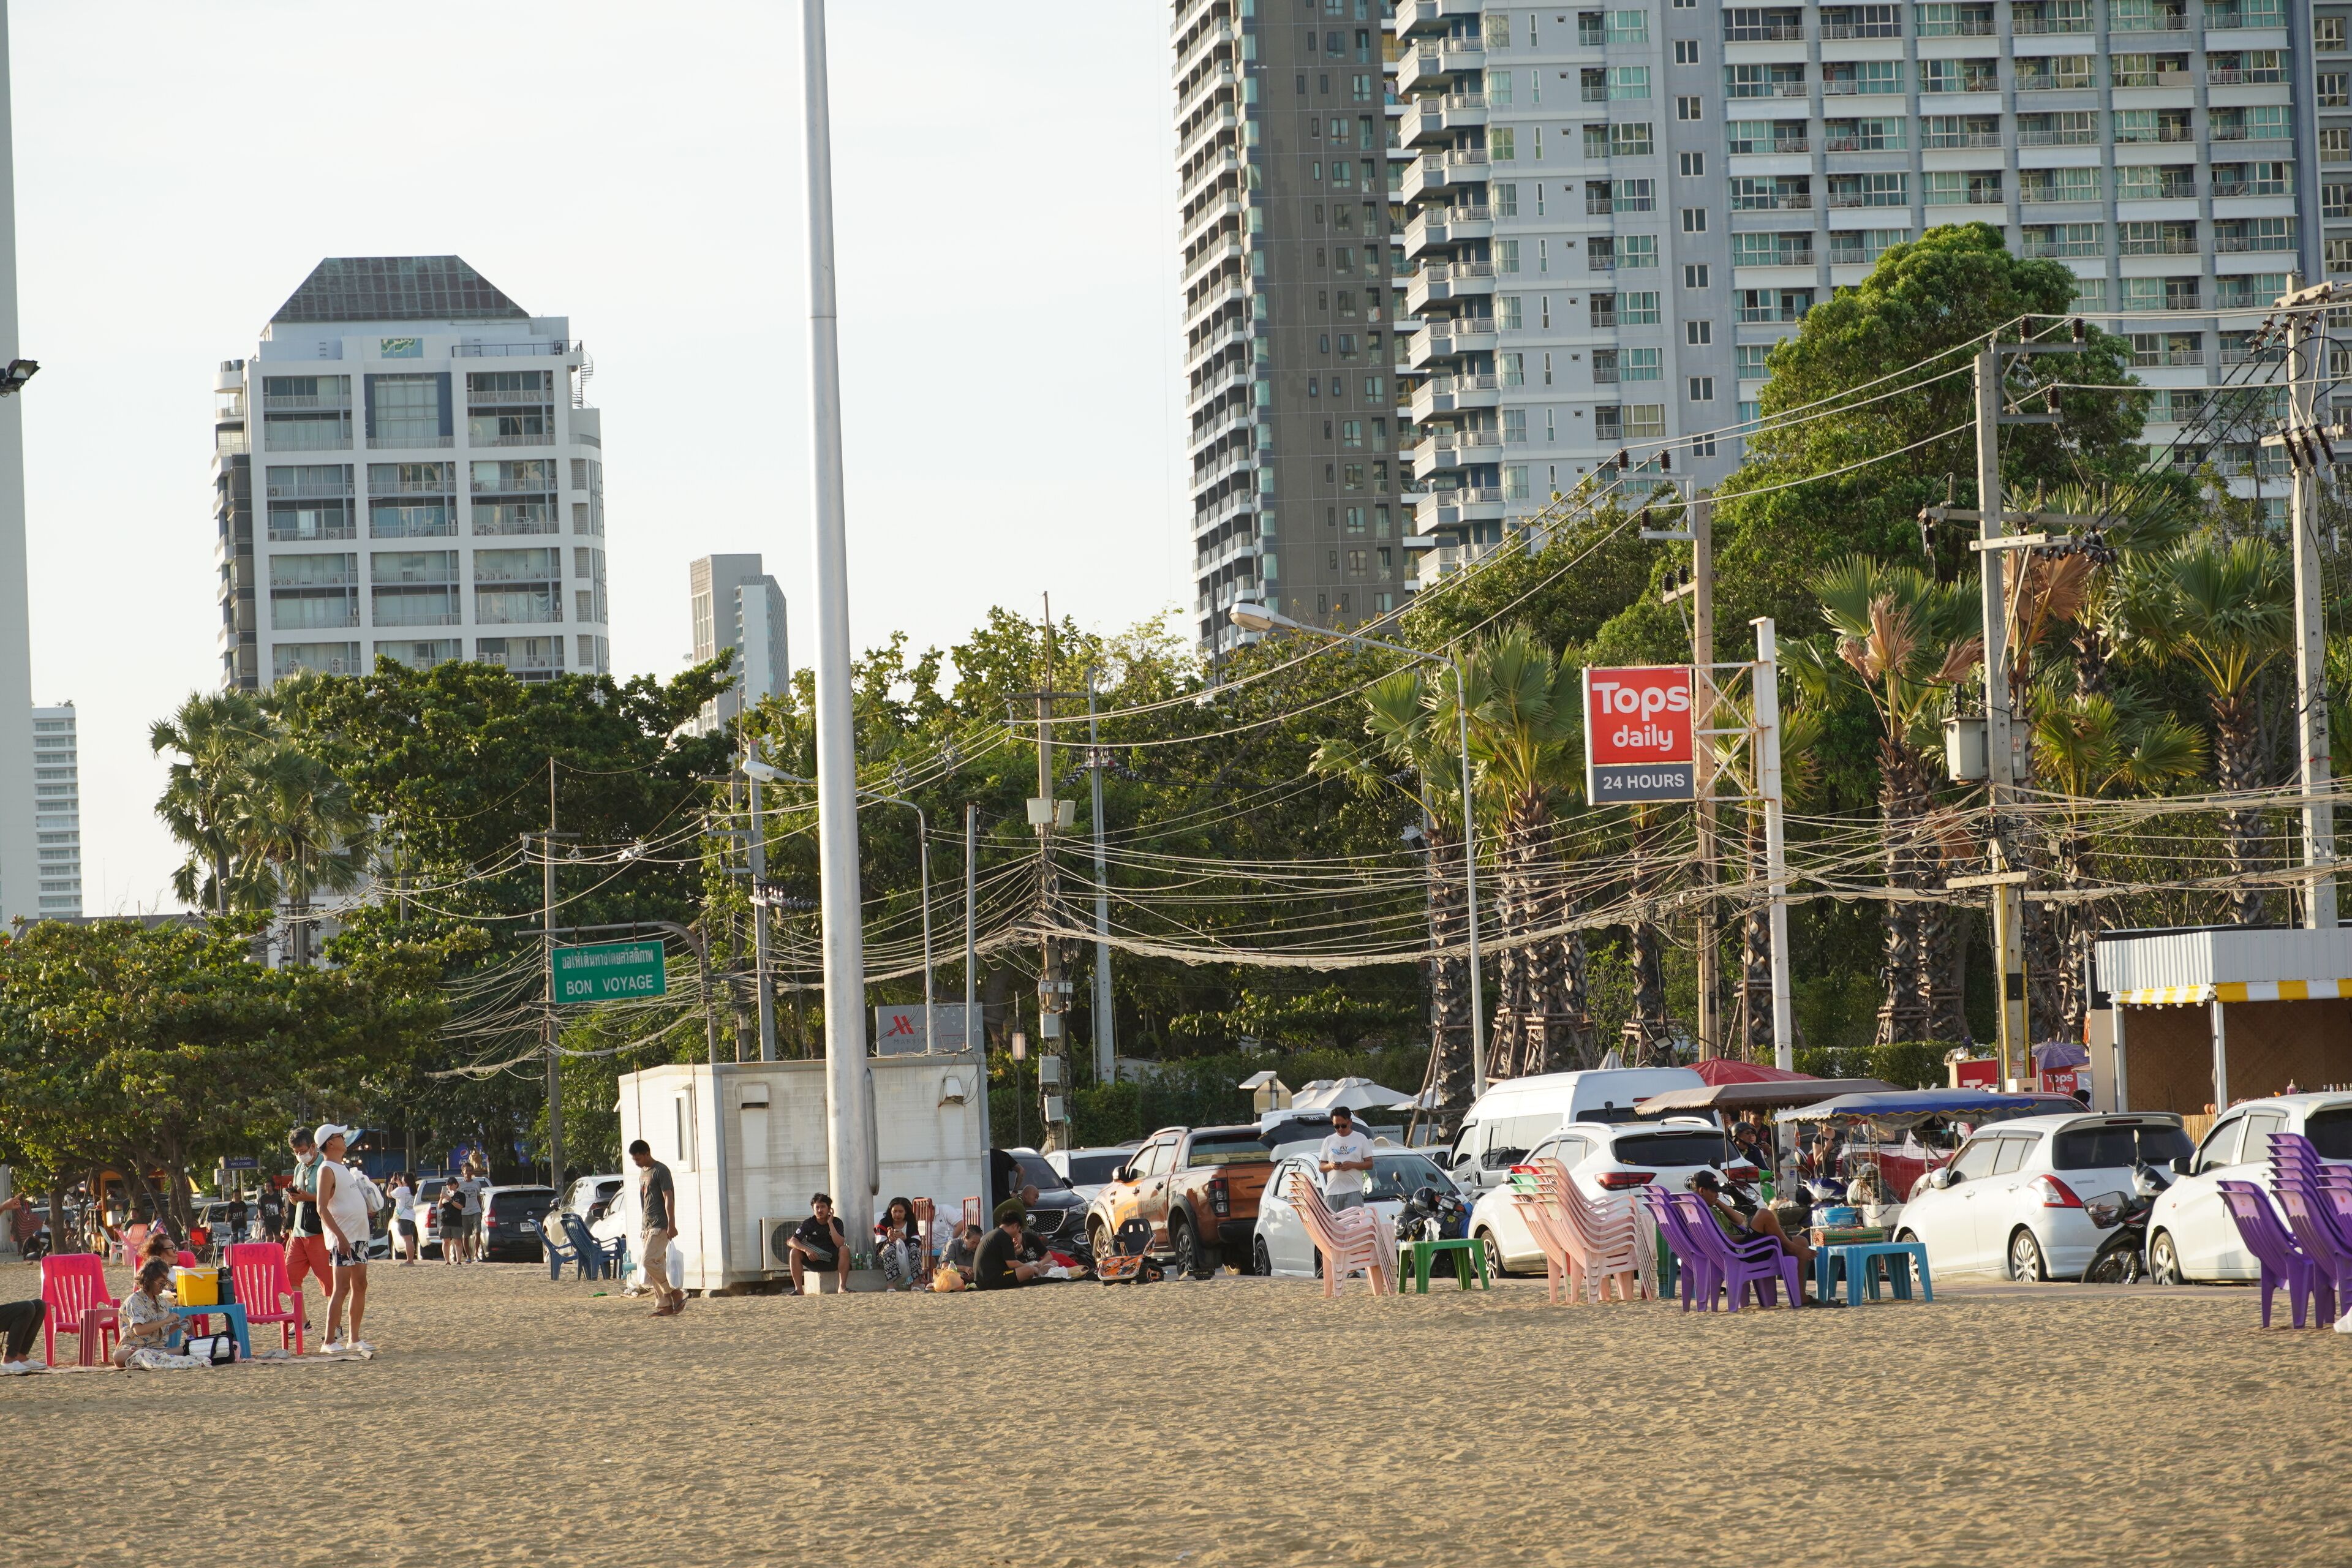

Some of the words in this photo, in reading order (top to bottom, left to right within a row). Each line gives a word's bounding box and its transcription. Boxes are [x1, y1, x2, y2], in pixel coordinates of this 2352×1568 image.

[1592, 682, 1690, 722] Tops
[1612, 724, 1673, 751] daily
[1603, 776, 1623, 790] 24
[1627, 774, 1685, 788] HOURS
[562, 947, 654, 969] ขอให้เดินทางโดยสวัสดิภาพ
[566, 979, 592, 995] BON
[603, 974, 654, 992] VOYAGE
